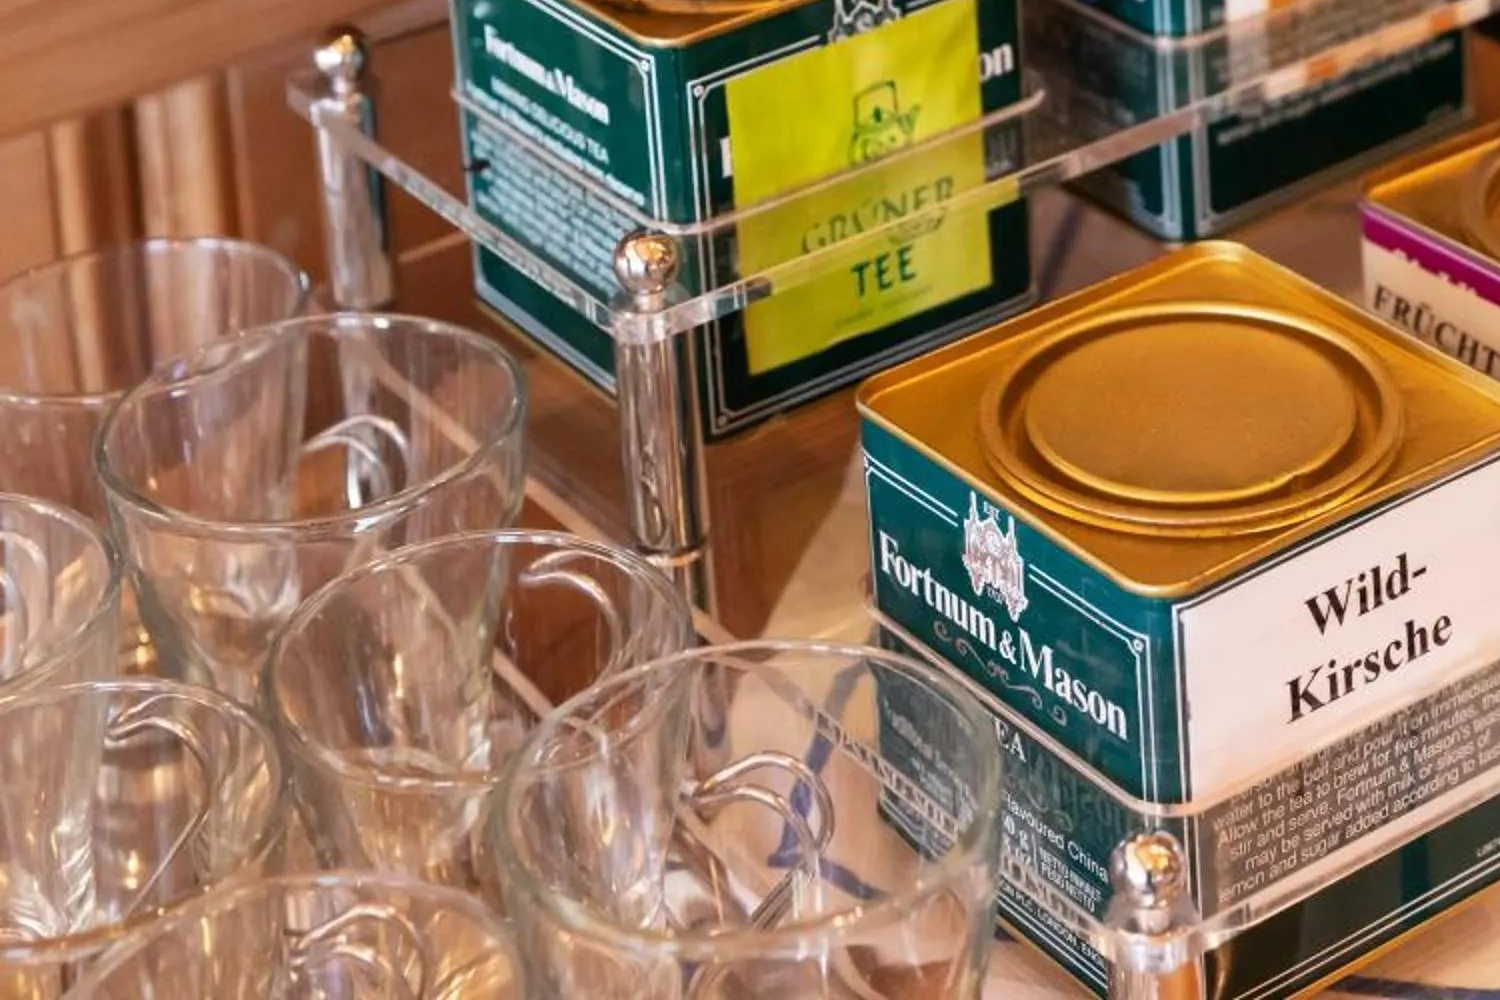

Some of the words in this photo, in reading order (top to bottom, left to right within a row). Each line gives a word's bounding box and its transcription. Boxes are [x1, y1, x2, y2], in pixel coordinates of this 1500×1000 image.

[851, 244, 917, 297] TEE
[878, 529, 998, 651] Fortnum
[1017, 626, 1129, 742] Mason
[1304, 552, 1428, 637] Wild-
[1286, 614, 1453, 725] Kirsche
[1363, 729, 1395, 760] pour
[1218, 816, 1259, 849] Allow
[1333, 762, 1370, 789] brew
[1257, 820, 1286, 849] and
[1336, 765, 1397, 807] Fortnum
[1066, 840, 1110, 884] China
[1244, 844, 1279, 872] may
